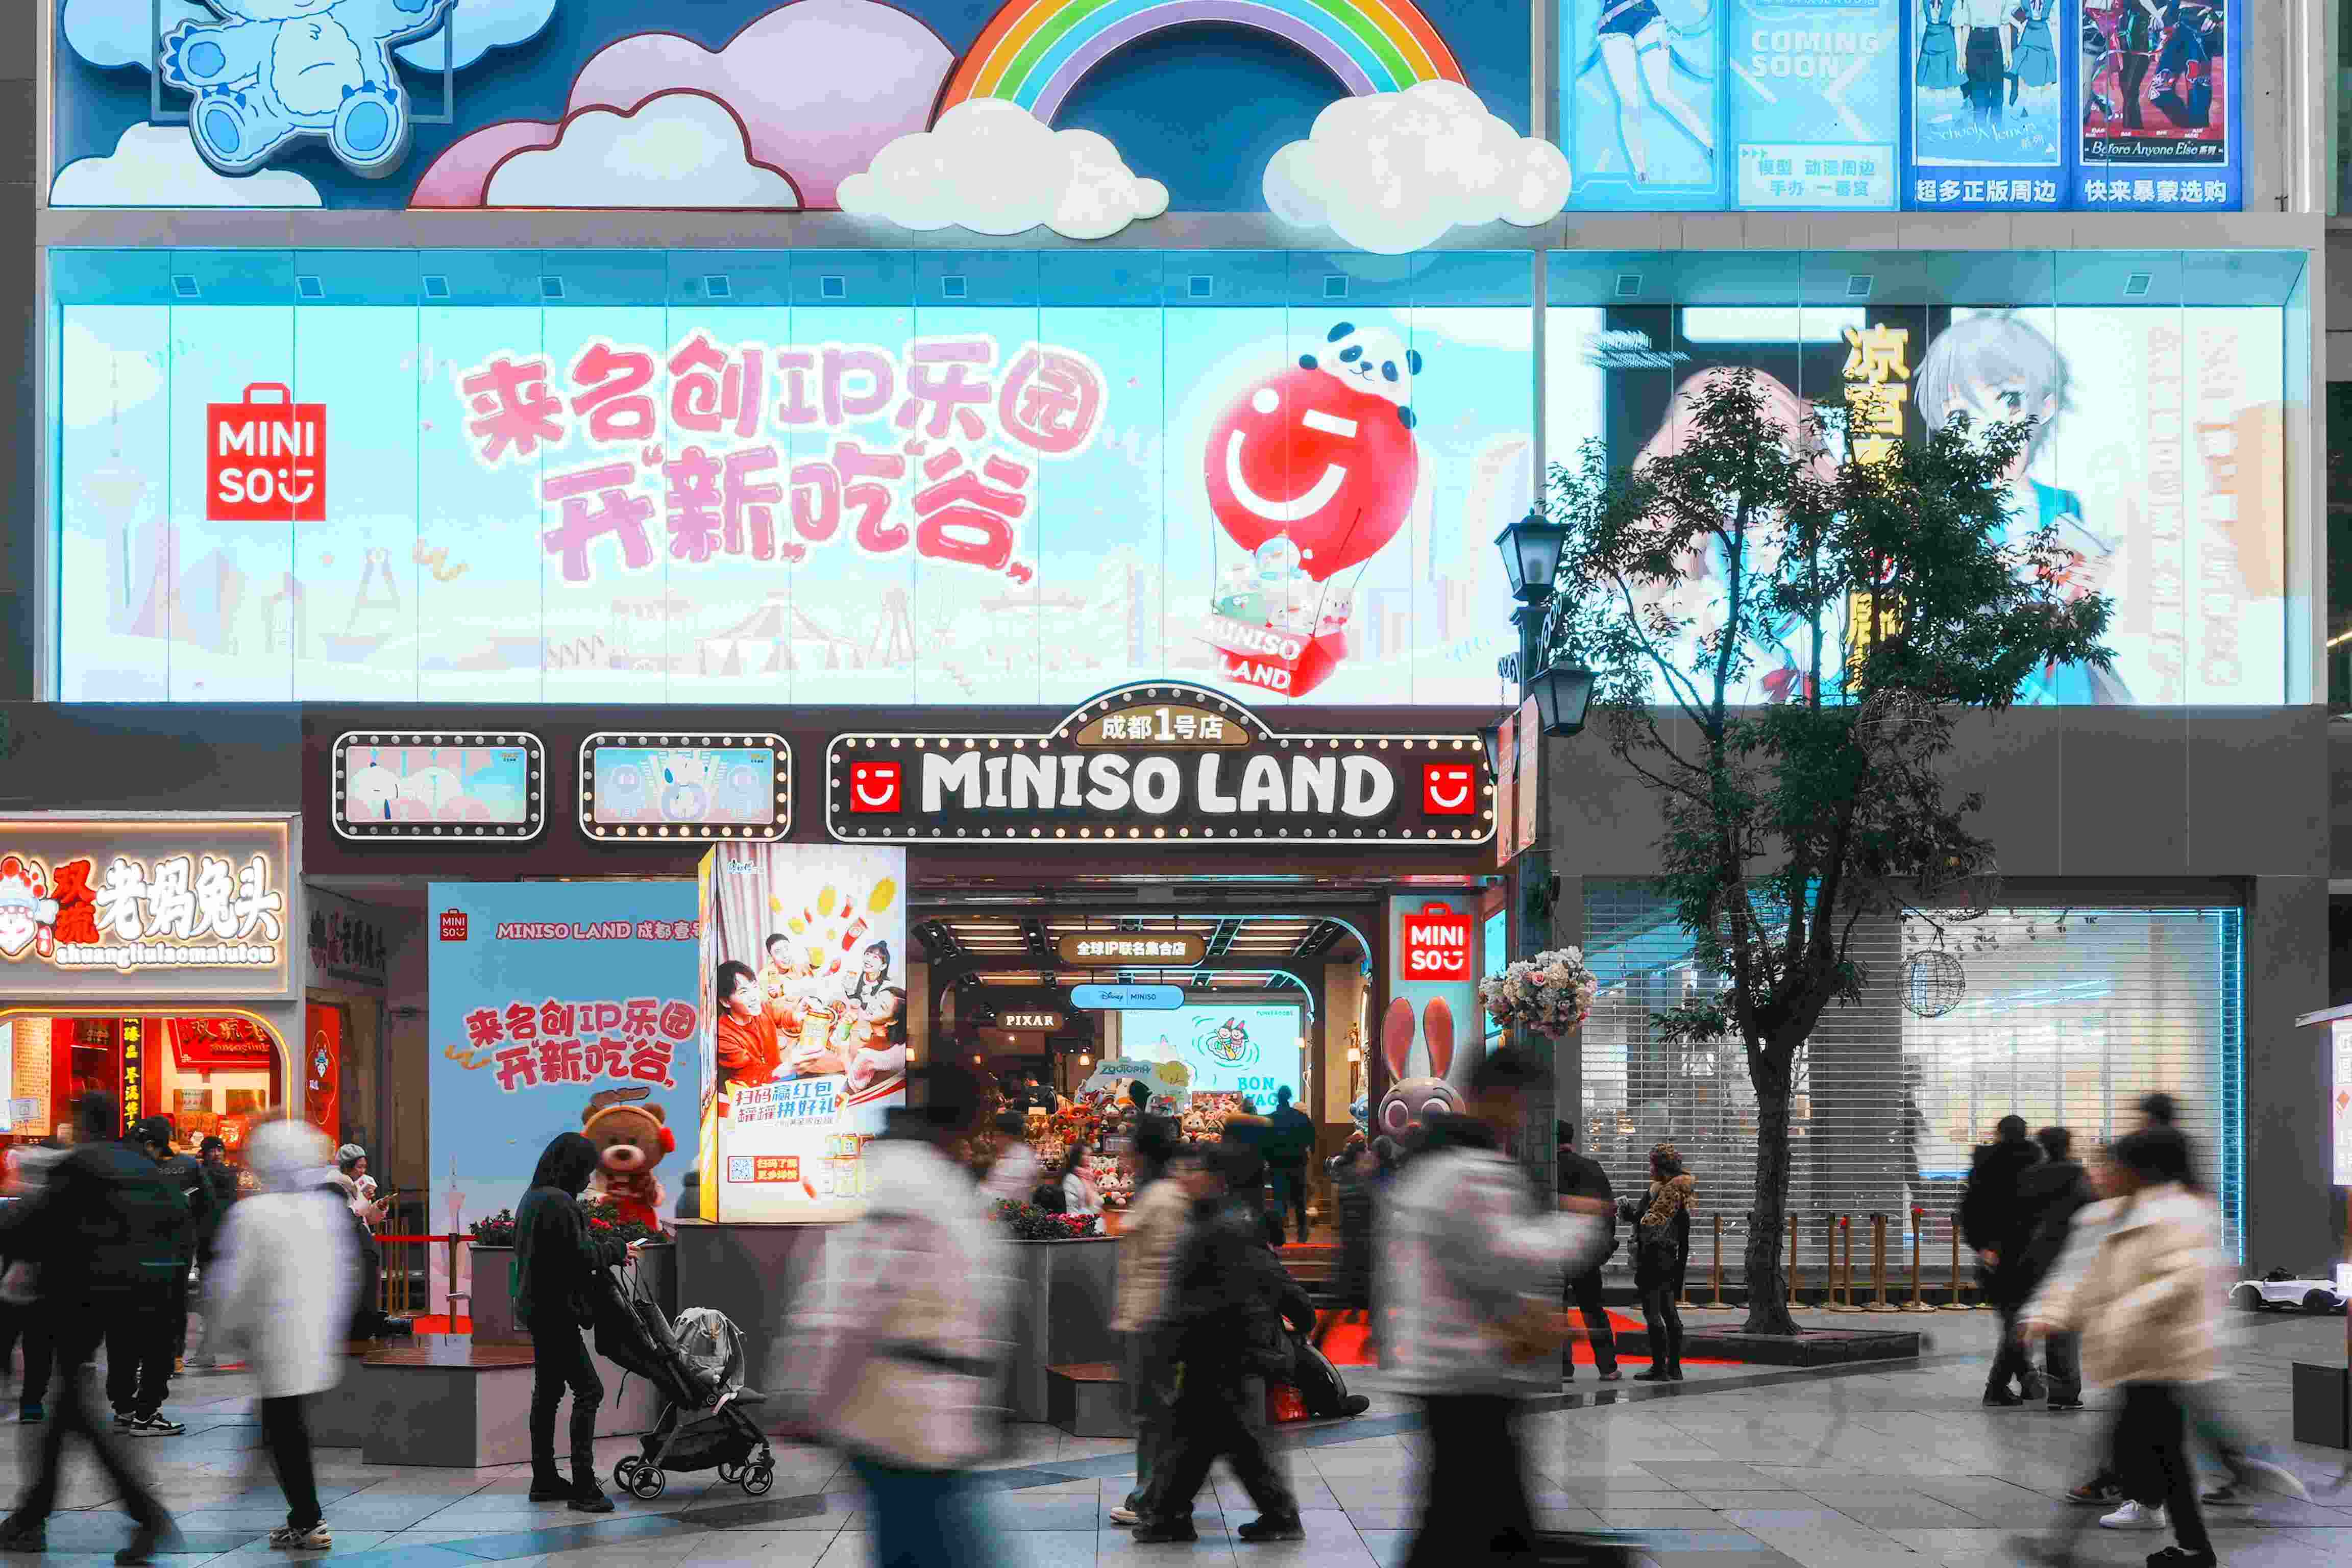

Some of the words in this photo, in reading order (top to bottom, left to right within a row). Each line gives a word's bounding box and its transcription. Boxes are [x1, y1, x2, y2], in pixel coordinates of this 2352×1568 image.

[1752, 32, 1879, 54] COMING
[1752, 54, 1839, 78] SOON
[2132, 140, 2173, 157] Anyone
[2175, 141, 2197, 155] Else
[1916, 179, 2058, 203] 超多正版周边
[462, 329, 1108, 462] 来名创IP乐园
[218, 420, 314, 456] MINI
[1100, 708, 1224, 741] 成都1号店
[922, 751, 1182, 815] MINISO
[1197, 754, 1394, 817] LAND
[442, 917, 464, 926] MINI
[496, 922, 569, 940] MINISO
[572, 922, 632, 940] LAND
[1411, 925, 1464, 946] MINI
[464, 998, 697, 1048] 来名创IP乐园
[1006, 1015, 1055, 1026] PIXAR
[735, 1081, 833, 1107] 扫码赢红包
[1238, 1076, 1275, 1091] BON
